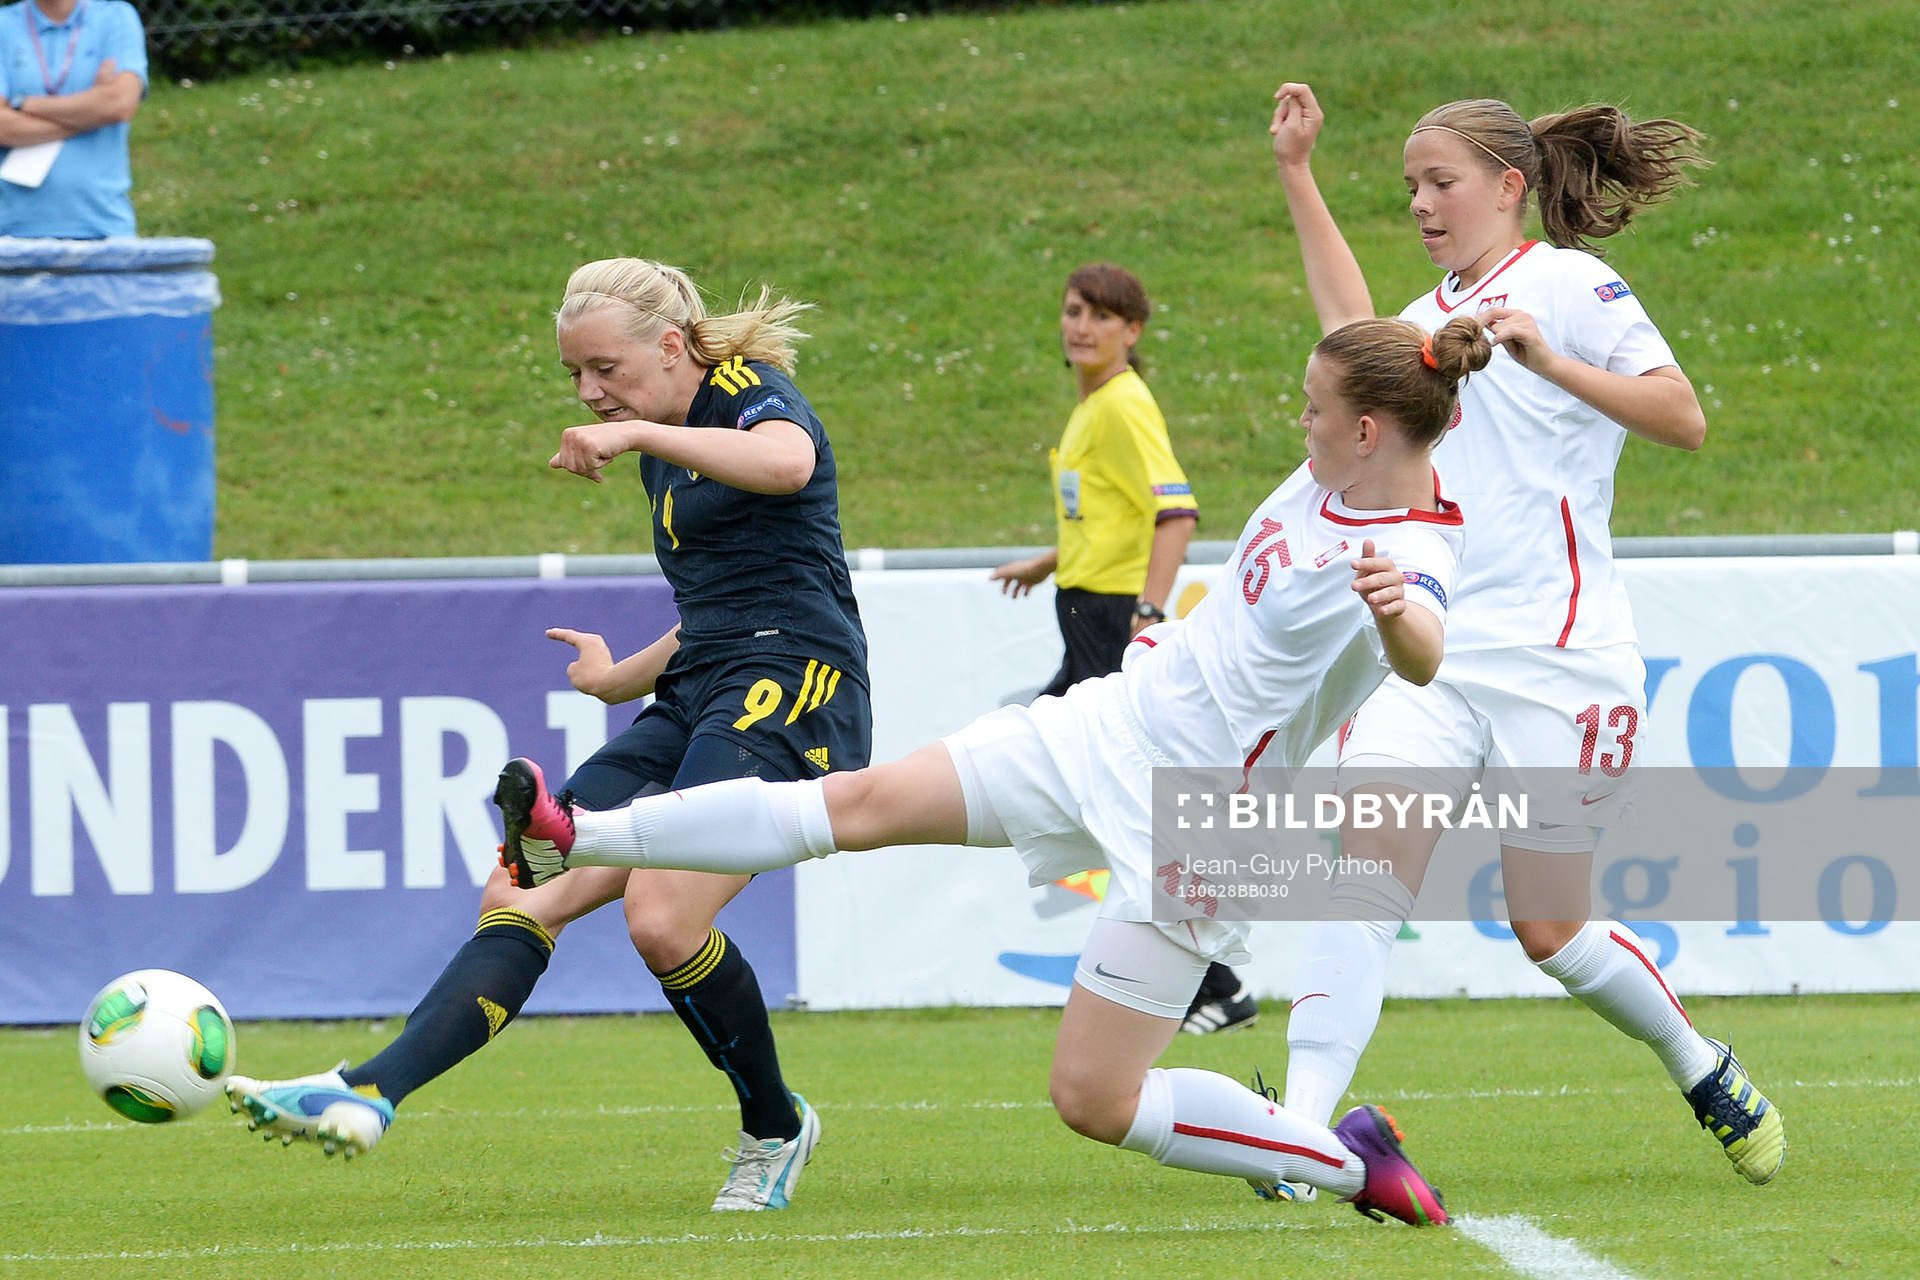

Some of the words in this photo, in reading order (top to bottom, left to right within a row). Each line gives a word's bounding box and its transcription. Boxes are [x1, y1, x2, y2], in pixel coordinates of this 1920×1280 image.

[1237, 517, 1292, 606] 15
[732, 678, 783, 732] 9
[1574, 703, 1639, 779] 13
[0, 696, 509, 897] NDER
[804, 750, 831, 771] adidas
